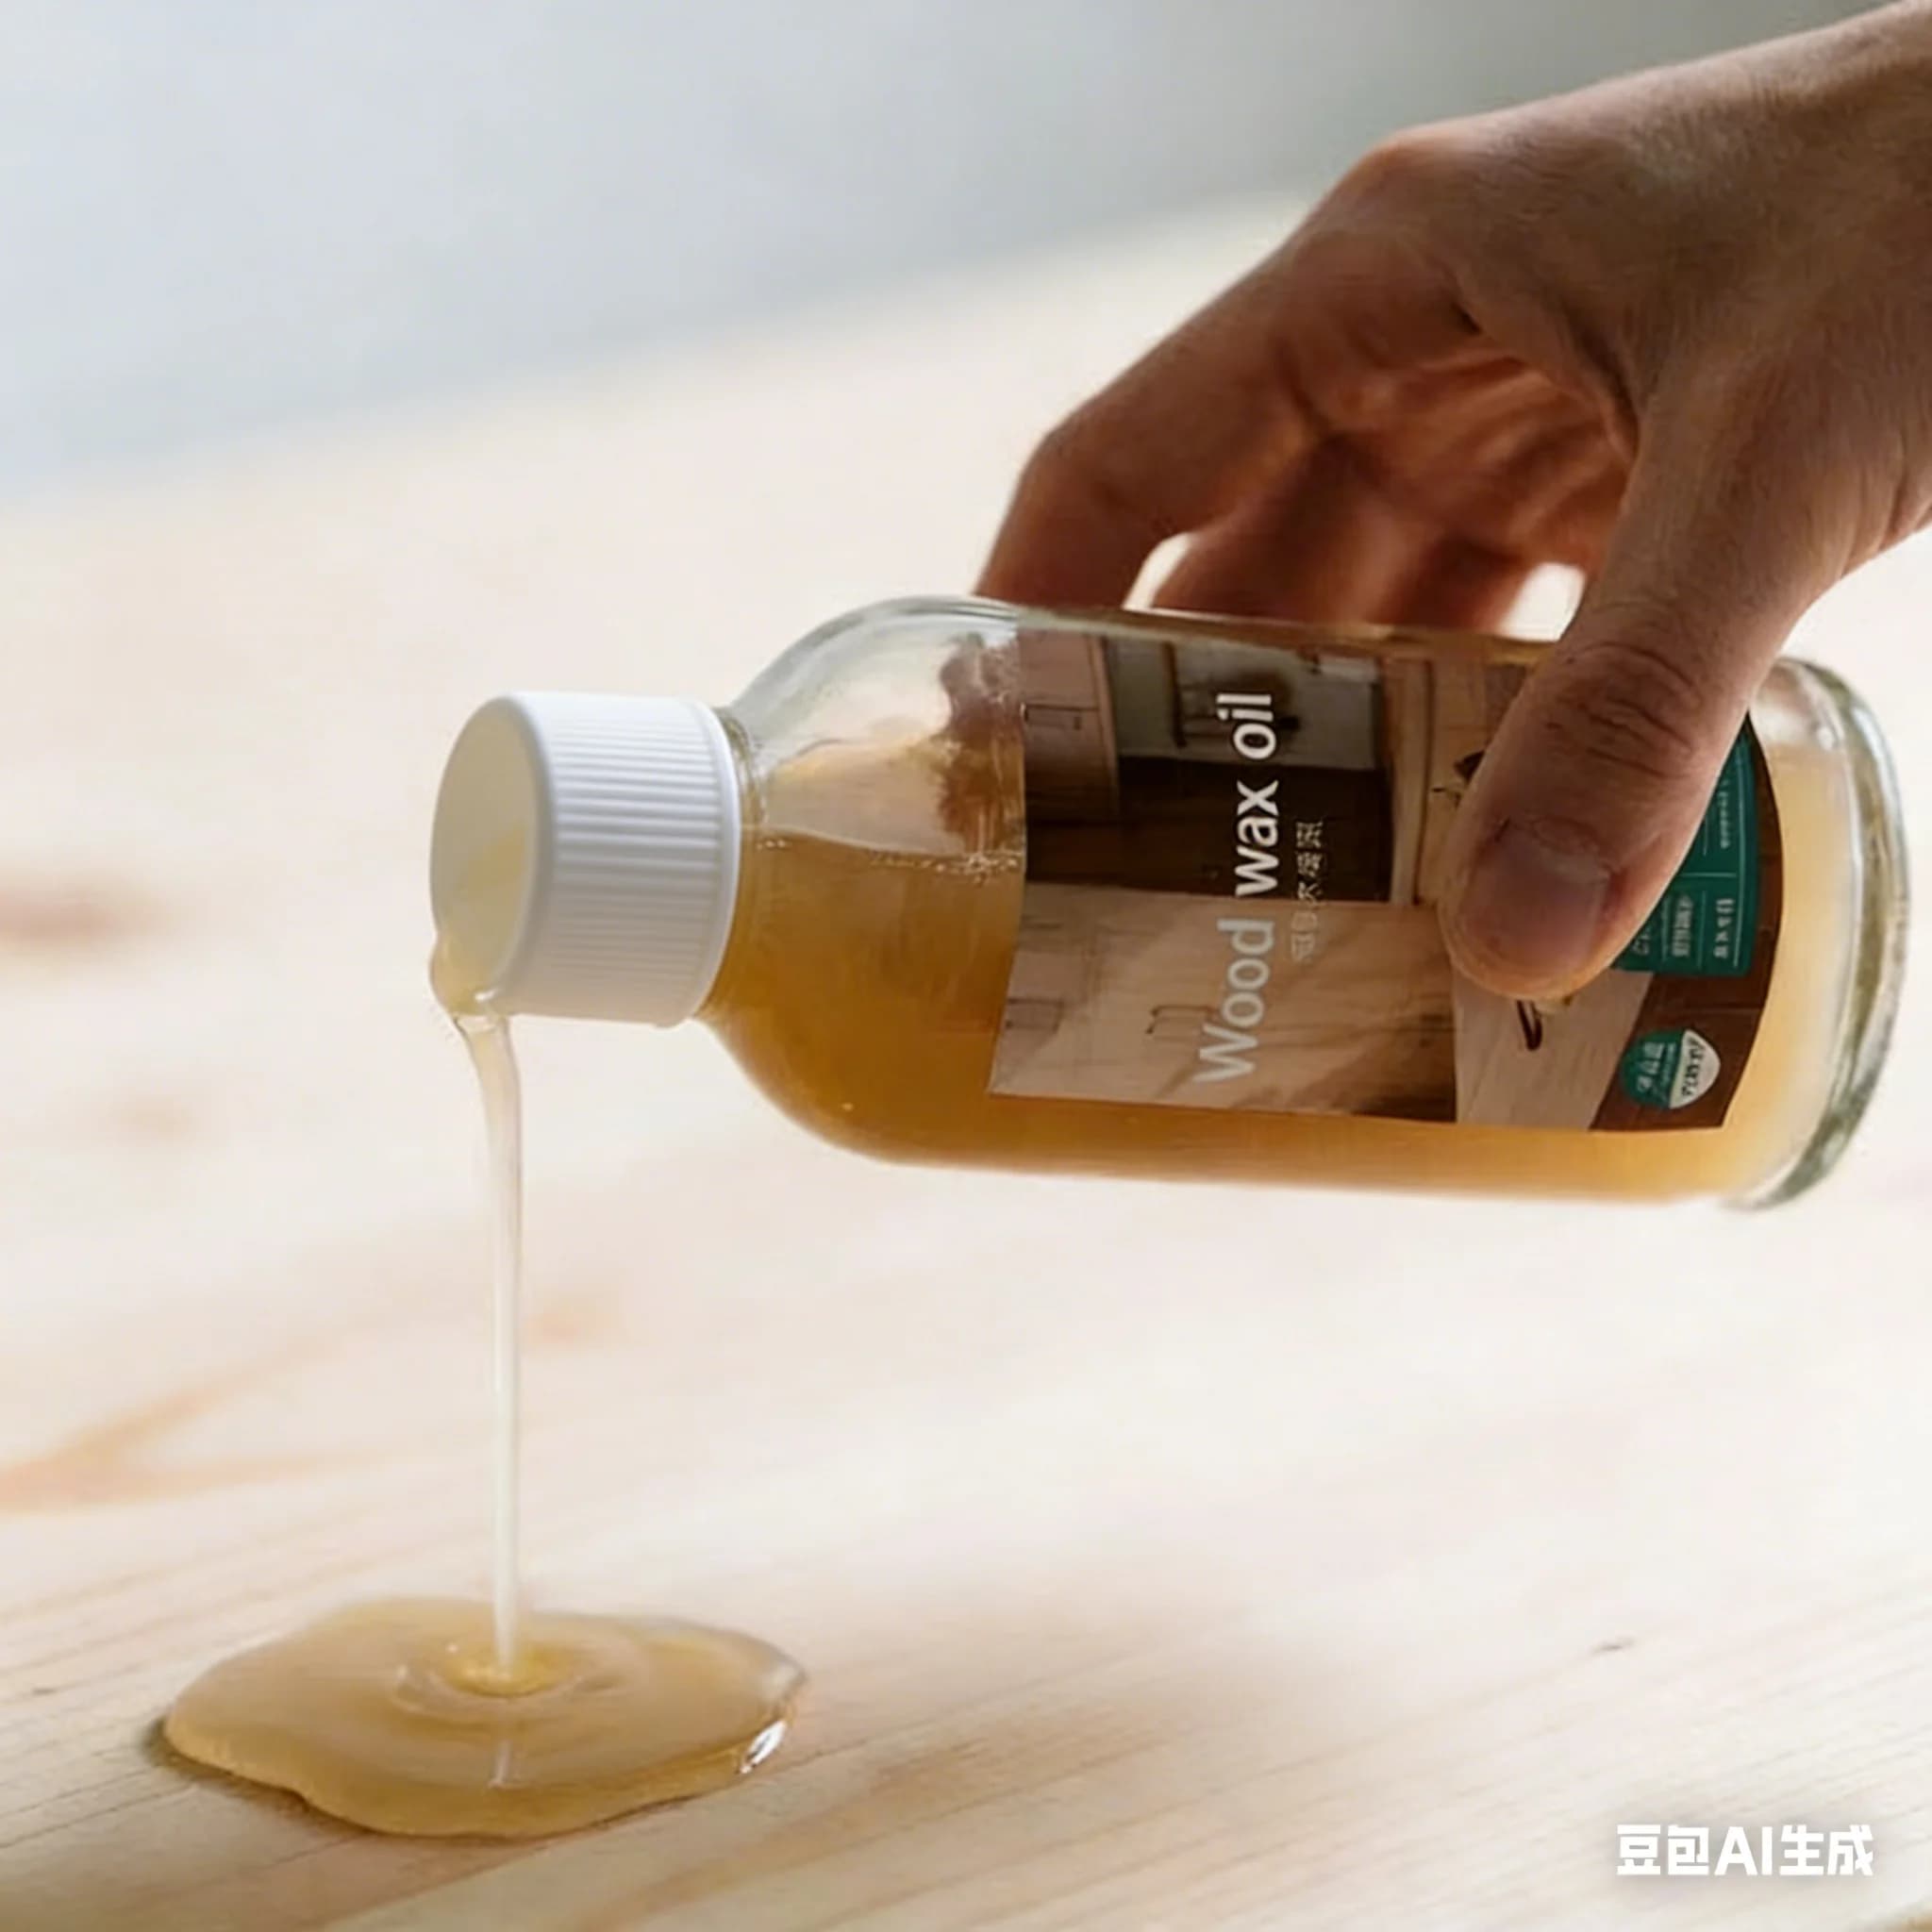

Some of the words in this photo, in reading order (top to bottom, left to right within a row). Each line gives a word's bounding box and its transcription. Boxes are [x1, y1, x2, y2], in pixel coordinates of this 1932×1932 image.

[1216, 693, 1276, 759] oil
[1234, 780, 1279, 895] wax
[1191, 919, 1275, 1082] Wood
